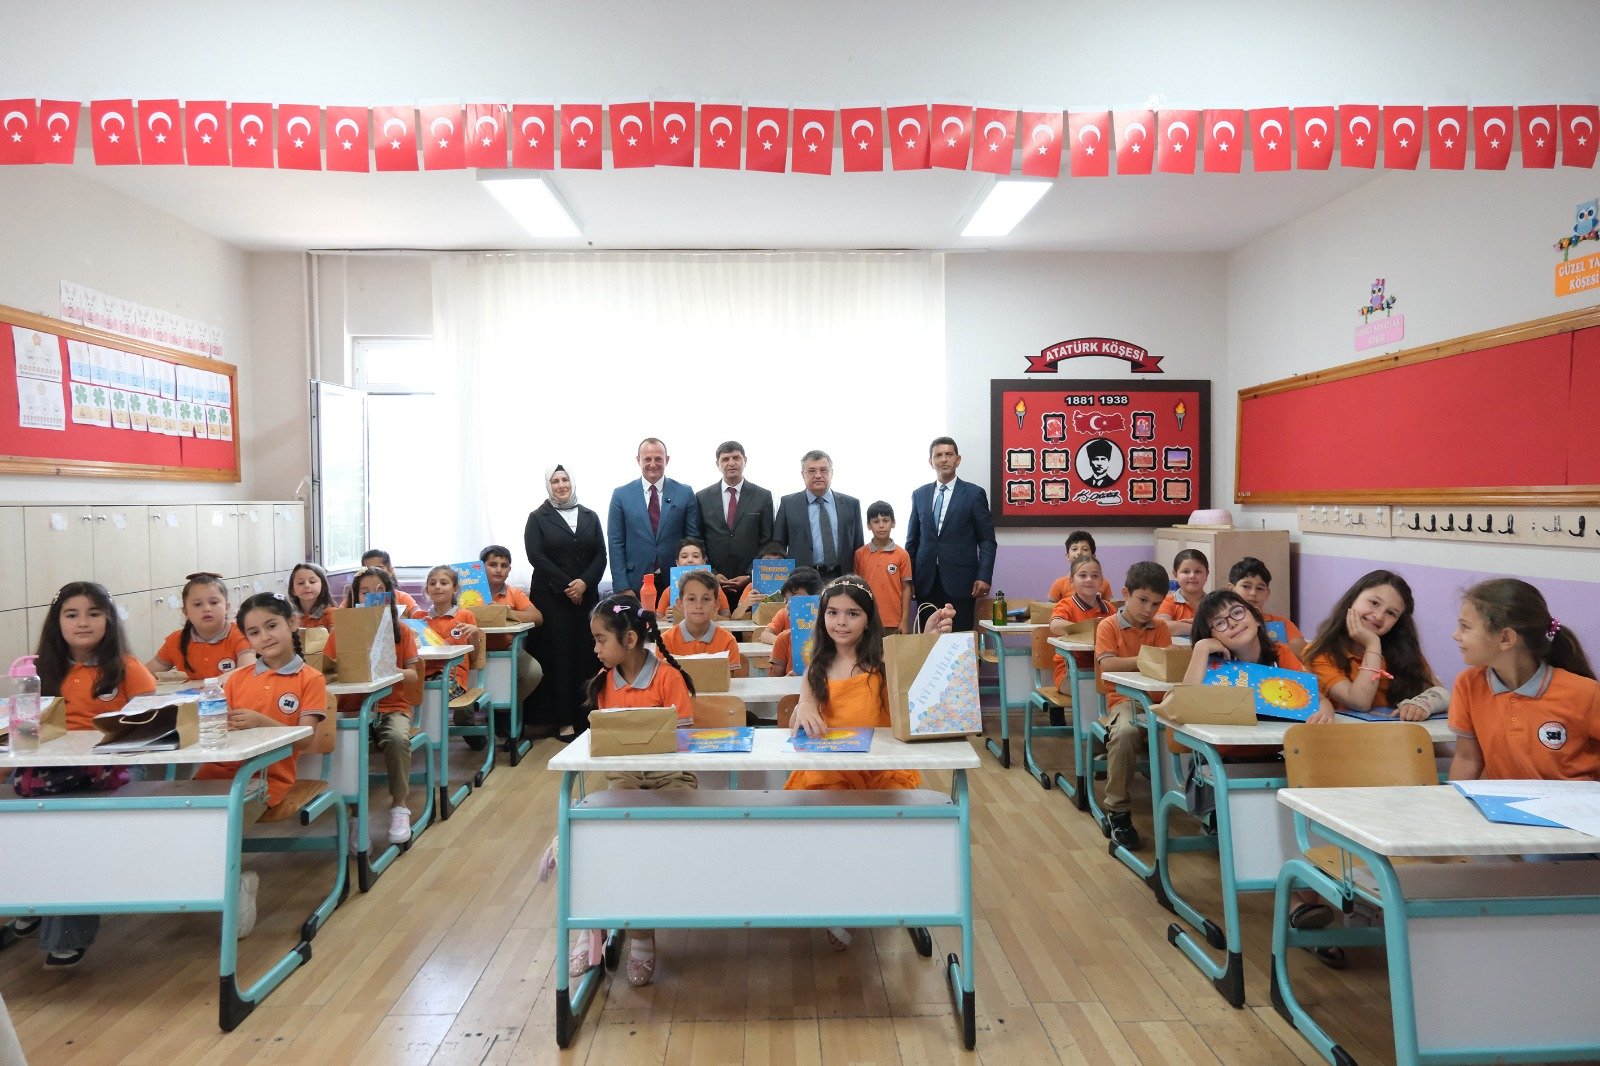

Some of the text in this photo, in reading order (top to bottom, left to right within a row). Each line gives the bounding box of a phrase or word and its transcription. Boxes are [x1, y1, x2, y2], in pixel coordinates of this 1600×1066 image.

[1559, 256, 1600, 276] GÜZEL YA
[1569, 271, 1600, 290] KÖŞESİ
[1046, 341, 1145, 361] ATATÜRK KÖŞESİ
[1065, 395, 1129, 405] 1881 1938
